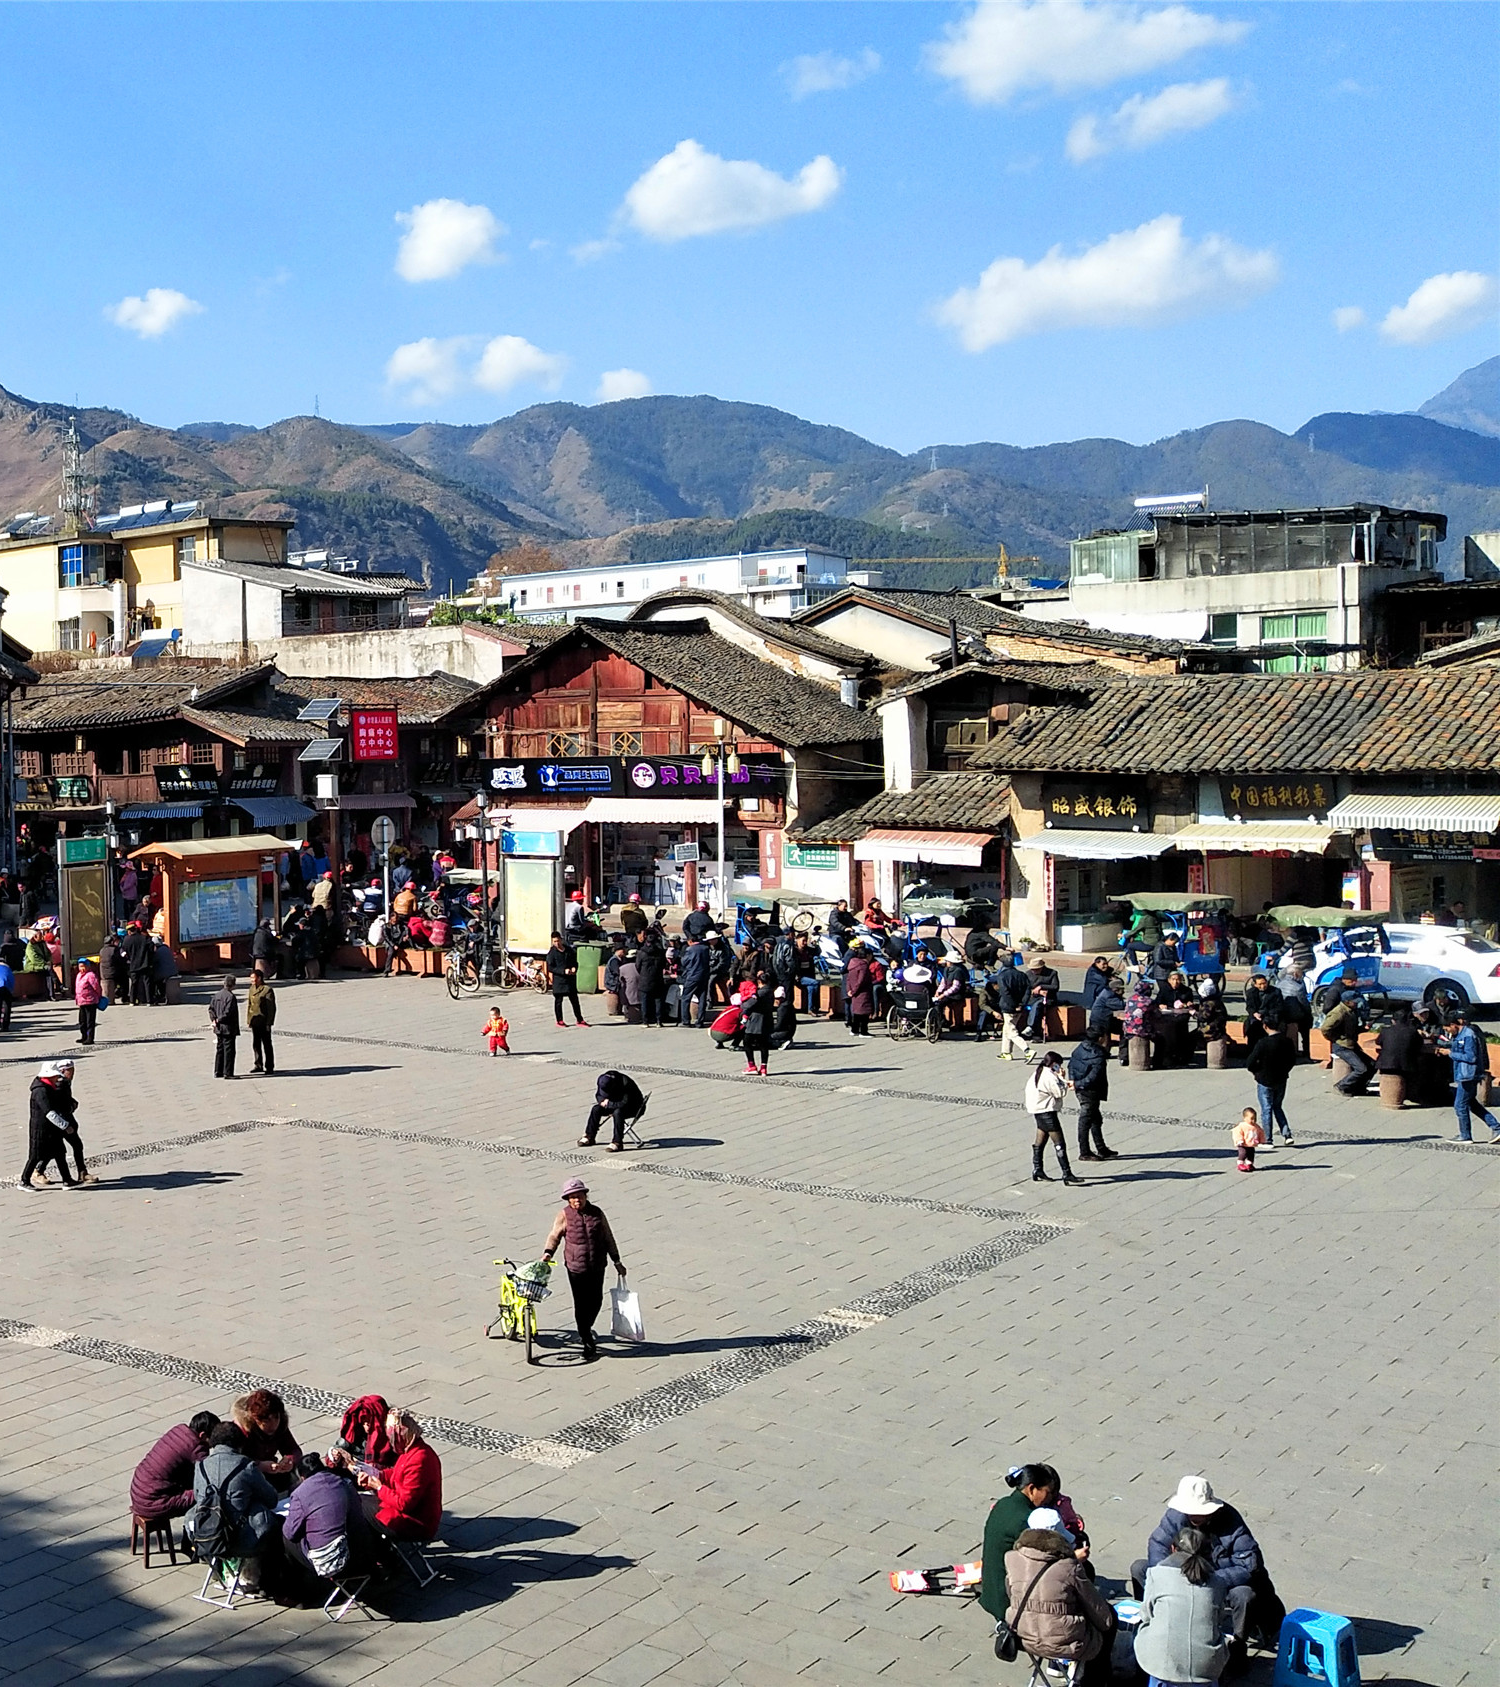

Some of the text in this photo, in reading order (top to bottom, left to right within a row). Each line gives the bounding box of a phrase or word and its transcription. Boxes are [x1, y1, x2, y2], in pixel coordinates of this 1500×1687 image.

[359, 728, 393, 737] 胸痛中心
[359, 738, 393, 748] 卒中中心
[1230, 783, 1327, 808] 中国福利彩票
[1051, 794, 1138, 819] 昭盛银饰
